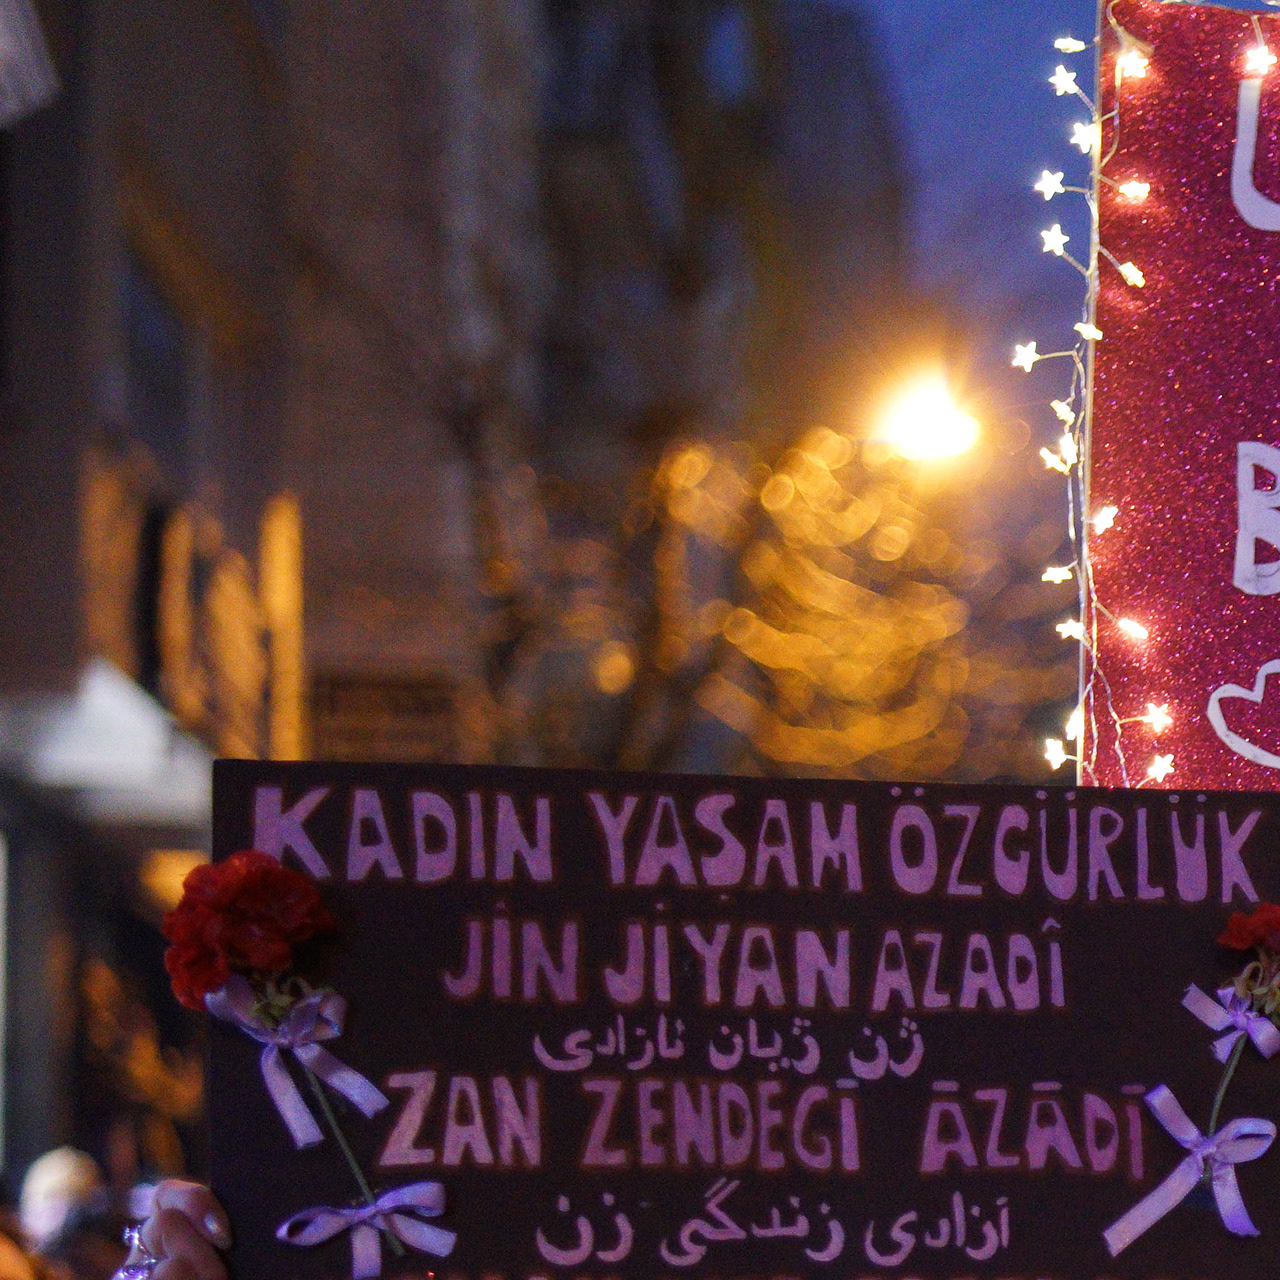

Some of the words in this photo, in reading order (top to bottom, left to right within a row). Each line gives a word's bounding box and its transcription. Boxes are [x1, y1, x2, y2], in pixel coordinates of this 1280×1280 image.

[253, 786, 553, 883] KADIN
[871, 917, 1066, 1012] AZADÎ
[379, 1070, 542, 1167] ZAN
[535, 1191, 634, 1266] زن
